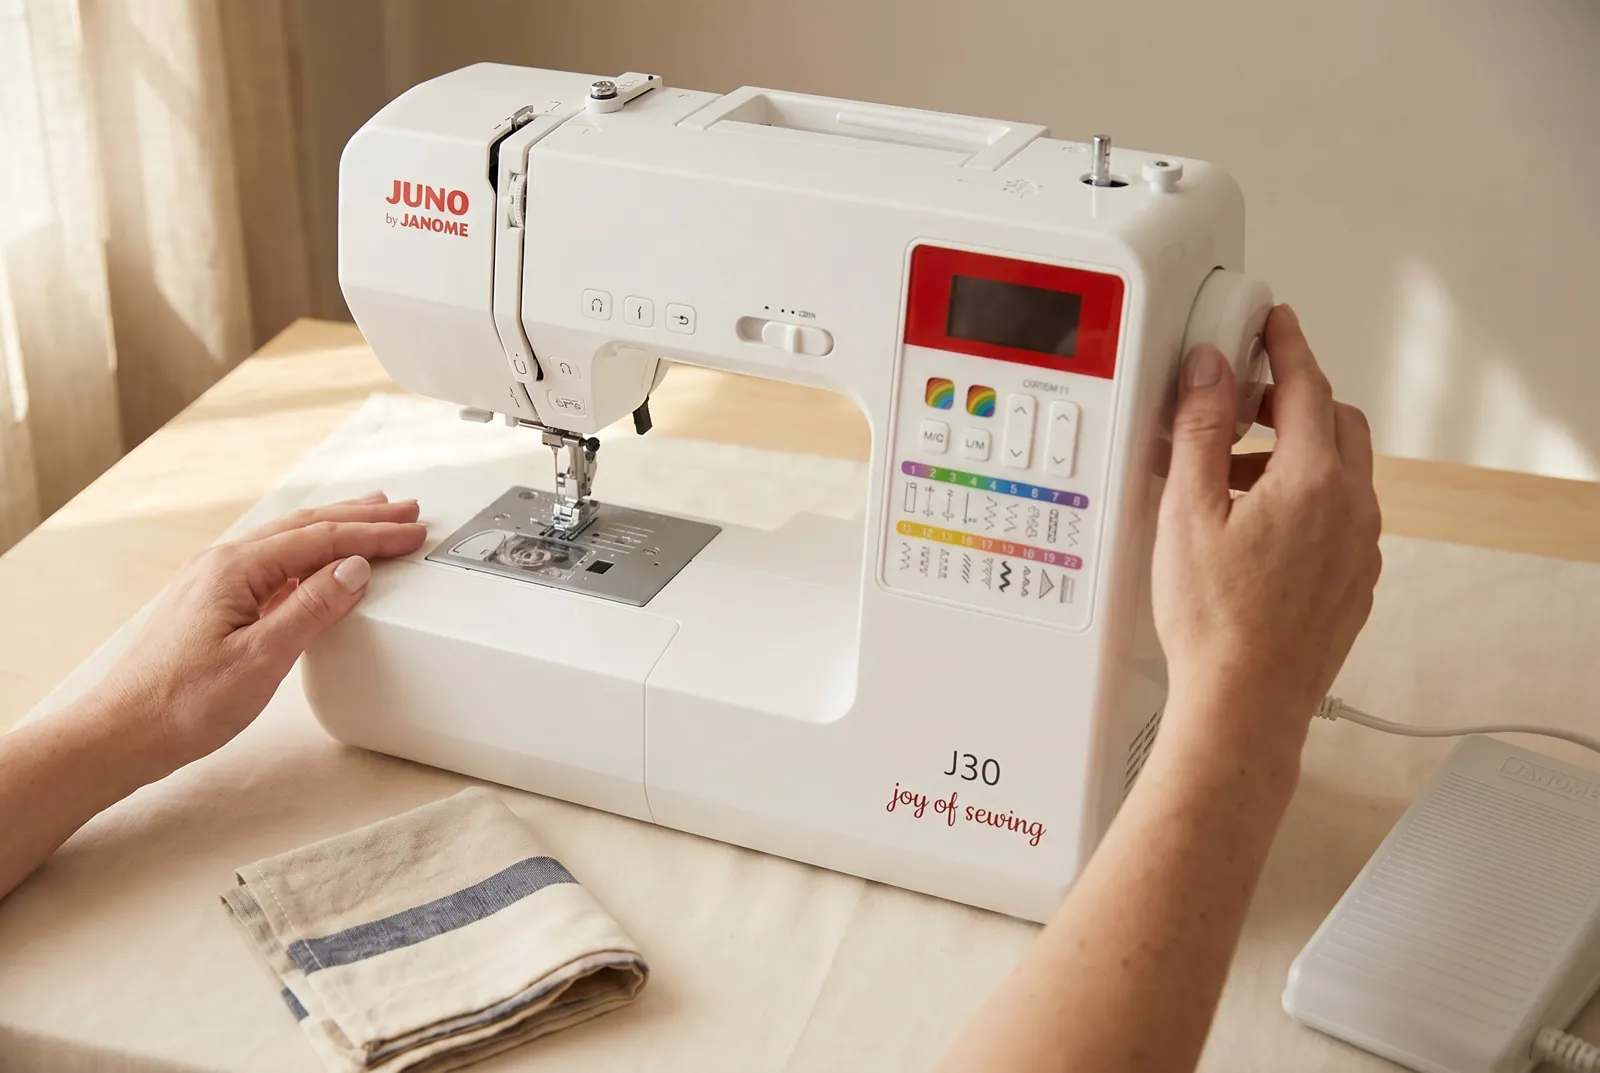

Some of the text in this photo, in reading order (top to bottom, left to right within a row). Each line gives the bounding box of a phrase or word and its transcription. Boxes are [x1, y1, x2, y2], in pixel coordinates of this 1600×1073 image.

[386, 180, 469, 216] JUNO
[386, 213, 468, 237] by JANOME
[924, 431, 944, 443] M/C
[929, 468, 937, 478] 2
[949, 472, 957, 483] 3
[970, 476, 978, 487] 4
[989, 480, 997, 491] 4
[1010, 484, 1018, 494] 5
[1031, 488, 1039, 498] 6
[1052, 492, 1060, 502] 7
[1043, 552, 1056, 563] 19
[1063, 556, 1078, 568] 22
[944, 750, 1000, 786] J30
[886, 782, 1047, 846] joy of sewing
